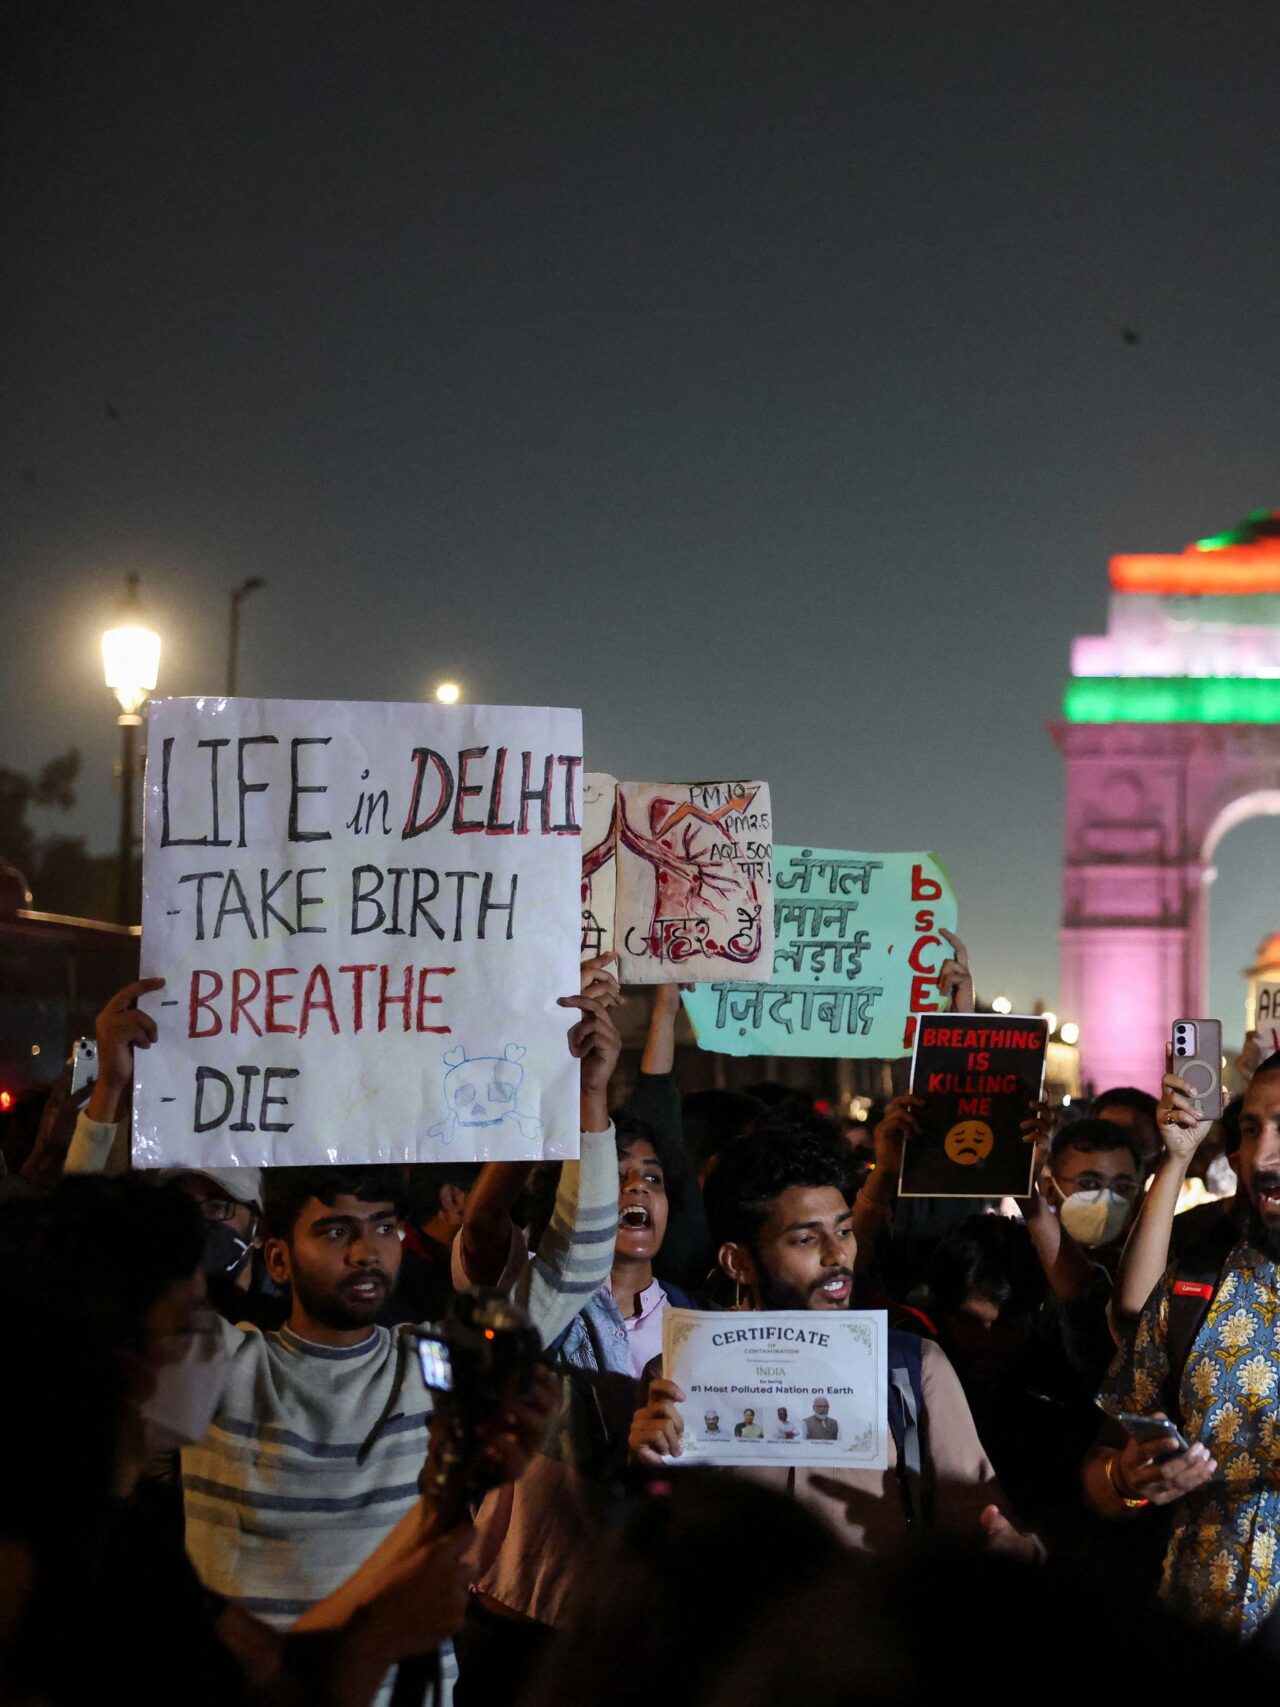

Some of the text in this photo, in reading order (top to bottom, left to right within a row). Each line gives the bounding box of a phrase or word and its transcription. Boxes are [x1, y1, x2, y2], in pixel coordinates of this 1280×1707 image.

[161, 736, 582, 848] LIFE in DELHI
[710, 842, 772, 861] AQI 500
[776, 849, 883, 894] जंगल
[351, 864, 518, 942] BIRTH
[728, 904, 762, 957] है
[922, 1028, 1041, 1050] BREATHING
[967, 1052, 990, 1071] IS
[928, 1073, 1018, 1094] KILLING
[957, 1097, 993, 1116] ME
[712, 1326, 831, 1347] CERTIFICATE
[756, 1367, 786, 1377] INDIA
[691, 1385, 701, 1393] #1
[704, 1385, 728, 1393] Most
[731, 1385, 773, 1394] Polluted
[775, 1386, 809, 1394] Nation
[827, 1387, 854, 1395] Earth
